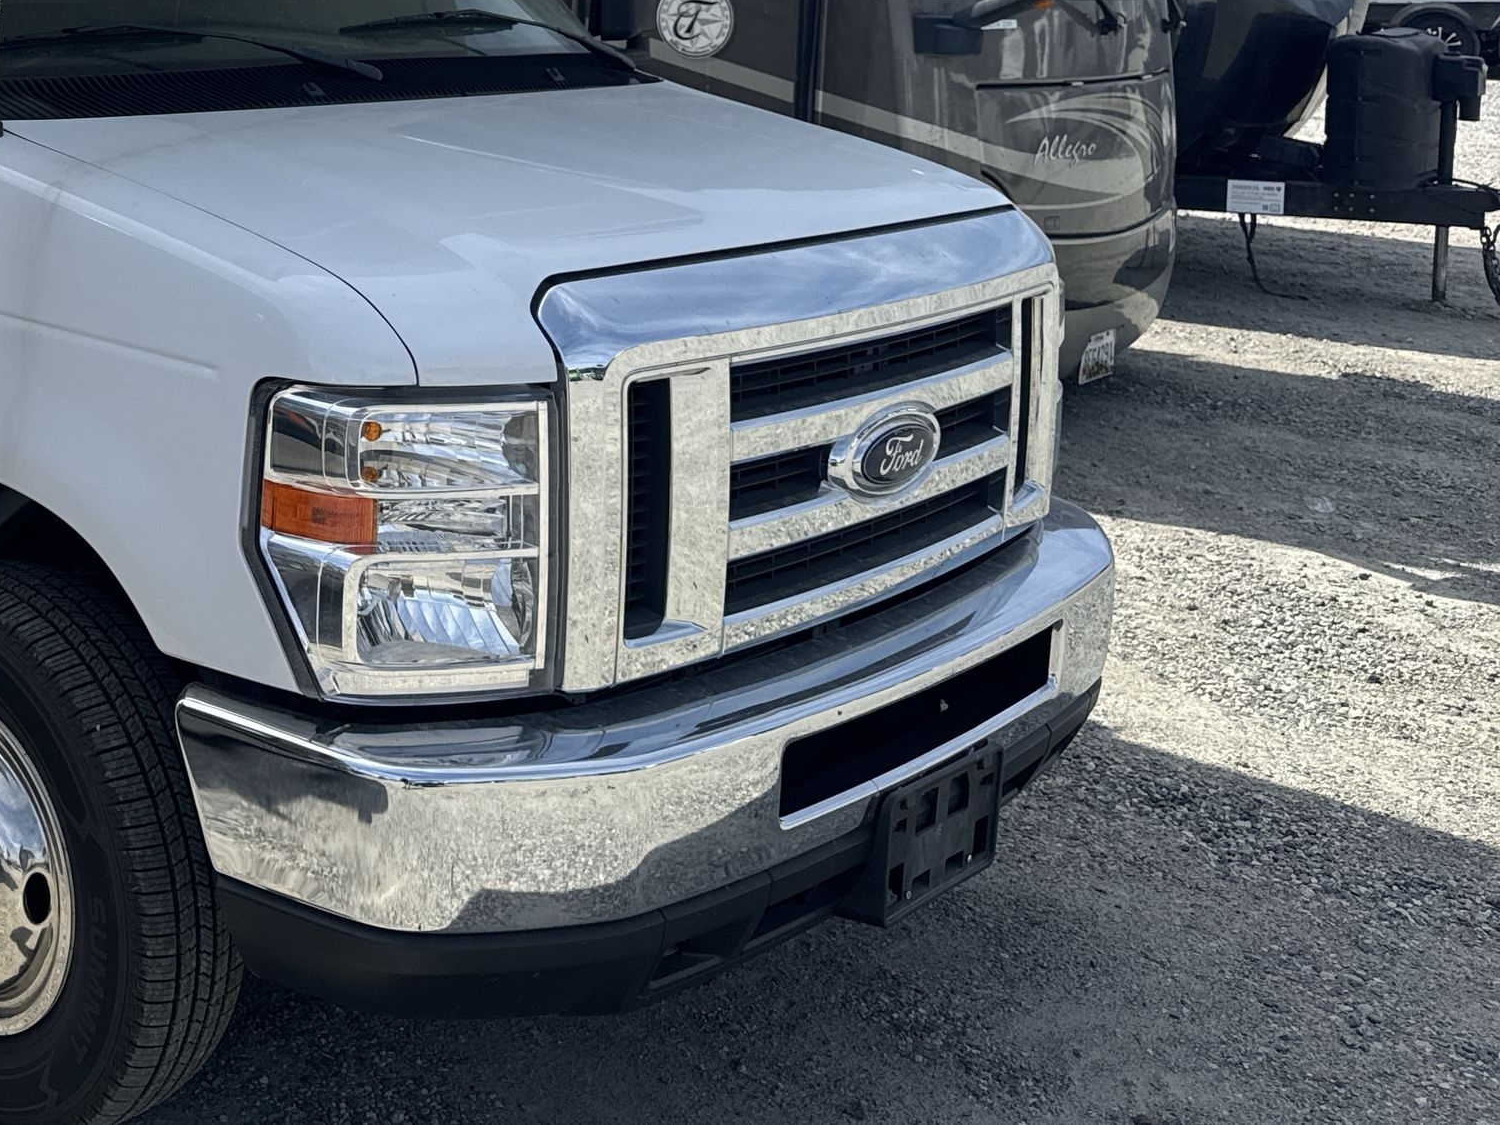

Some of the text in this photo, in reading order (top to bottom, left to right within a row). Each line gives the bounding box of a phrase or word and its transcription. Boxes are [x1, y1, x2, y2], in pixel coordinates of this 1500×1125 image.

[1033, 134, 1096, 169] Allegro
[880, 434, 924, 475] Ford
[70, 896, 108, 1065] SUMMIT
